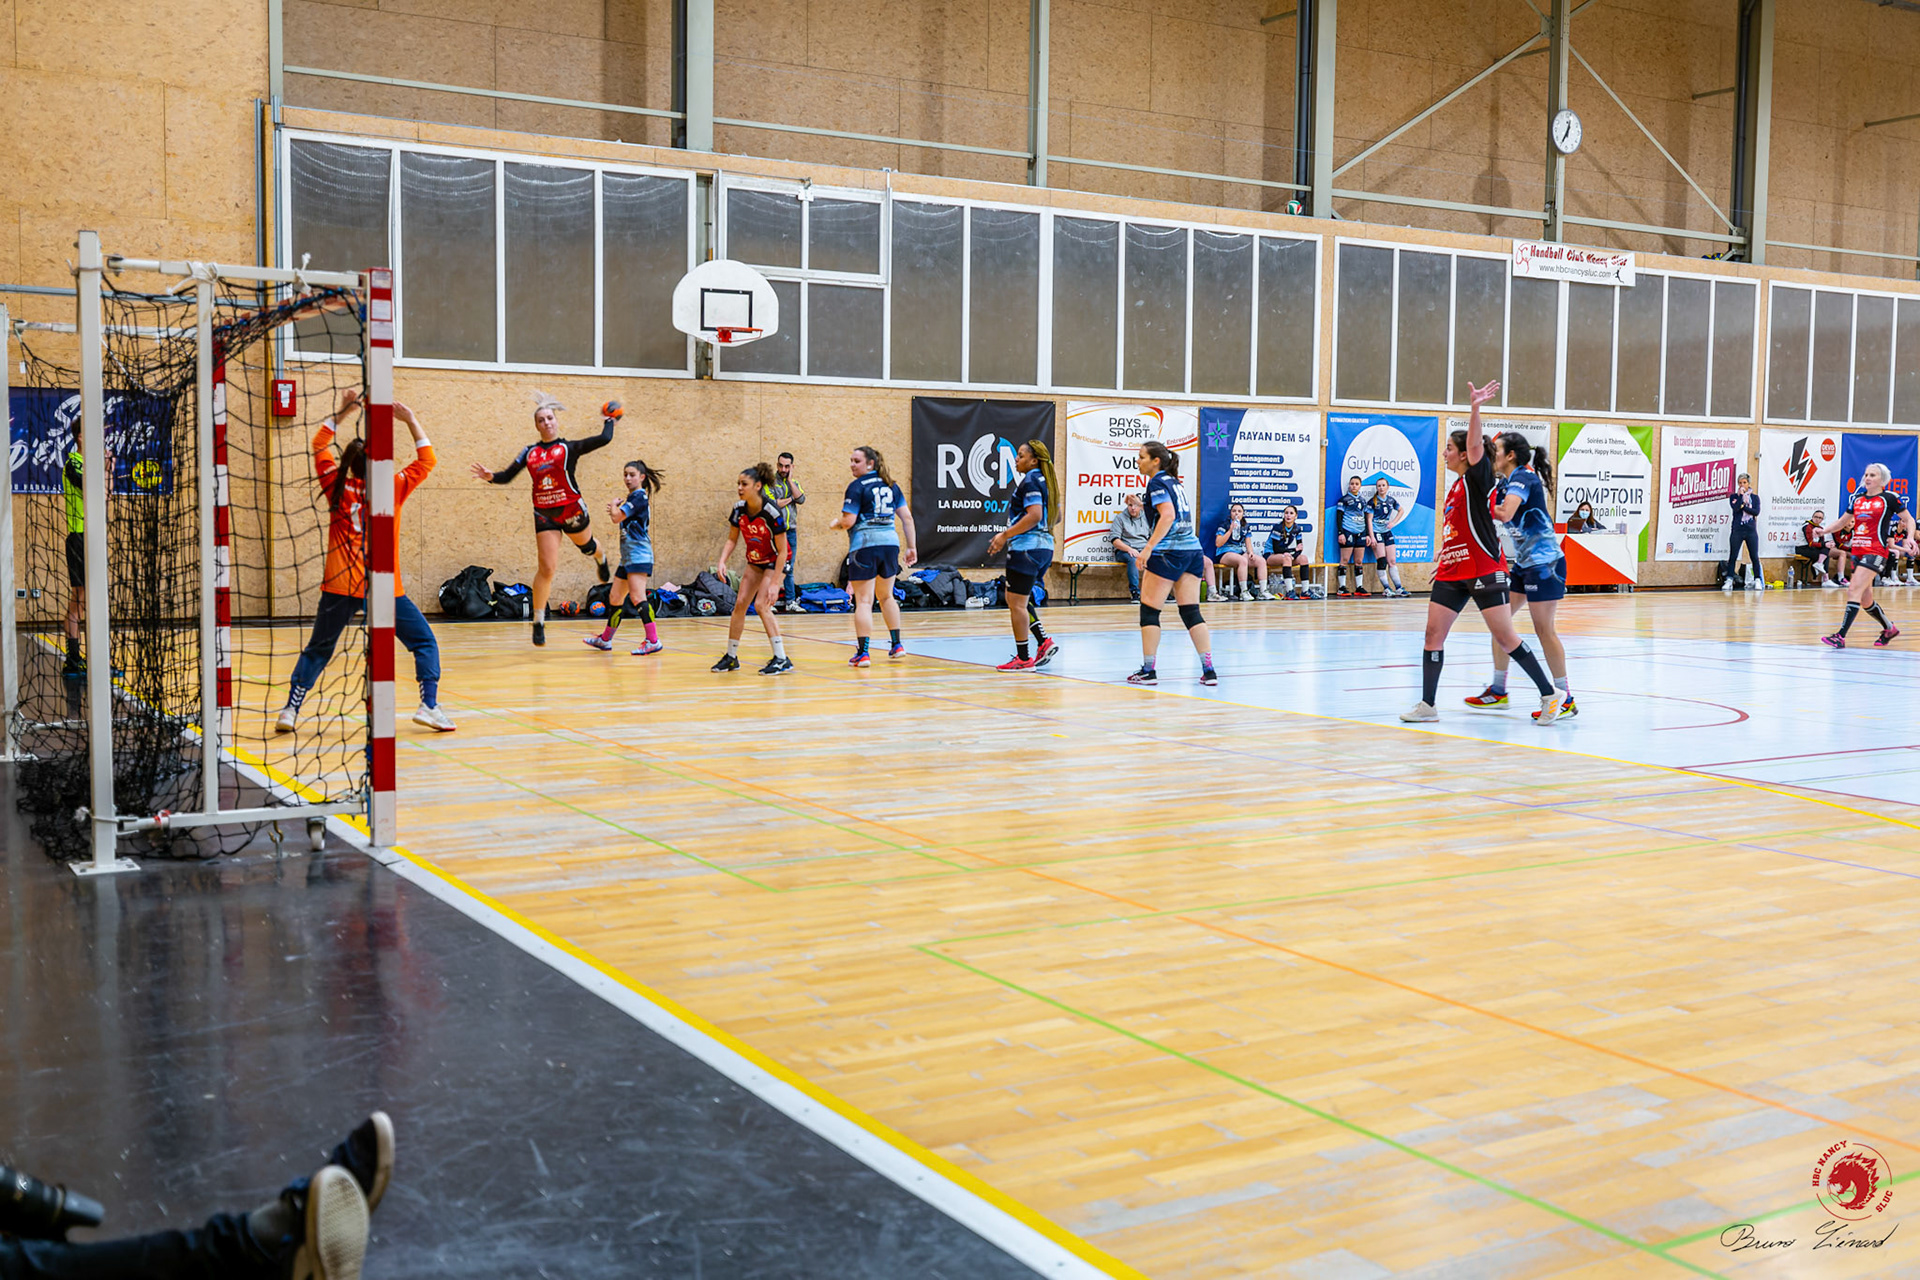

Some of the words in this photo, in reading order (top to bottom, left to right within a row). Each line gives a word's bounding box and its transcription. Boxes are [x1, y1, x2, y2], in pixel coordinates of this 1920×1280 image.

[1530, 245, 1563, 260] Handball
[1566, 249, 1585, 263] Club
[1538, 264, 1612, 278] www.hbcnancysluc.com
[1109, 417, 1141, 428] PAYS
[1487, 421, 1513, 429] ensemble
[1514, 422, 1529, 430] votre
[1529, 423, 1547, 431] avenir
[1071, 432, 1103, 445] Particulier
[1166, 433, 1195, 445] Entreprise
[1239, 431, 1273, 442] RAYAN
[1275, 433, 1296, 443] DEM
[1298, 433, 1311, 443] 54
[1608, 438, 1627, 446] Thème,
[1569, 447, 1594, 455] Afterwork,
[1594, 448, 1609, 456] Happy
[1610, 448, 1623, 456] Hour,
[1112, 456, 1139, 470] Vot
[1233, 455, 1281, 464] Déménagement
[1347, 456, 1370, 473] Guy
[1372, 456, 1415, 474] Hoquet
[1233, 469, 1262, 477] Transport
[1598, 471, 1610, 482] LE
[1676, 468, 1700, 496] Cave
[1705, 462, 1730, 491] Léon
[1233, 482, 1250, 490] Vente
[1260, 483, 1288, 491] Matériels
[872, 486, 894, 514] 12
[1093, 492, 1112, 506] de
[1172, 484, 1190, 513] 10
[1564, 487, 1644, 504] COMPTOIR
[1771, 496, 1826, 505] HelloHomeLorraine
[938, 500, 952, 509] LA
[952, 500, 982, 509] RADIO
[983, 500, 1009, 513] 90.7
[1592, 505, 1627, 521] mpanile
[1673, 514, 1684, 524] 03
[1685, 514, 1694, 525] 83
[1696, 514, 1706, 525] 17
[1708, 514, 1717, 525] 84
[1719, 515, 1730, 525] 57
[747, 525, 758, 535] 10
[937, 524, 969, 533] Partenaire
[969, 524, 978, 532] du
[978, 525, 992, 533] HBC
[993, 525, 1008, 533] Nan
[1376, 533, 1383, 542] 6
[1767, 531, 1777, 541] 06
[1780, 532, 1789, 541] 21
[1401, 550, 1415, 558] 447
[1415, 550, 1428, 558] 077
